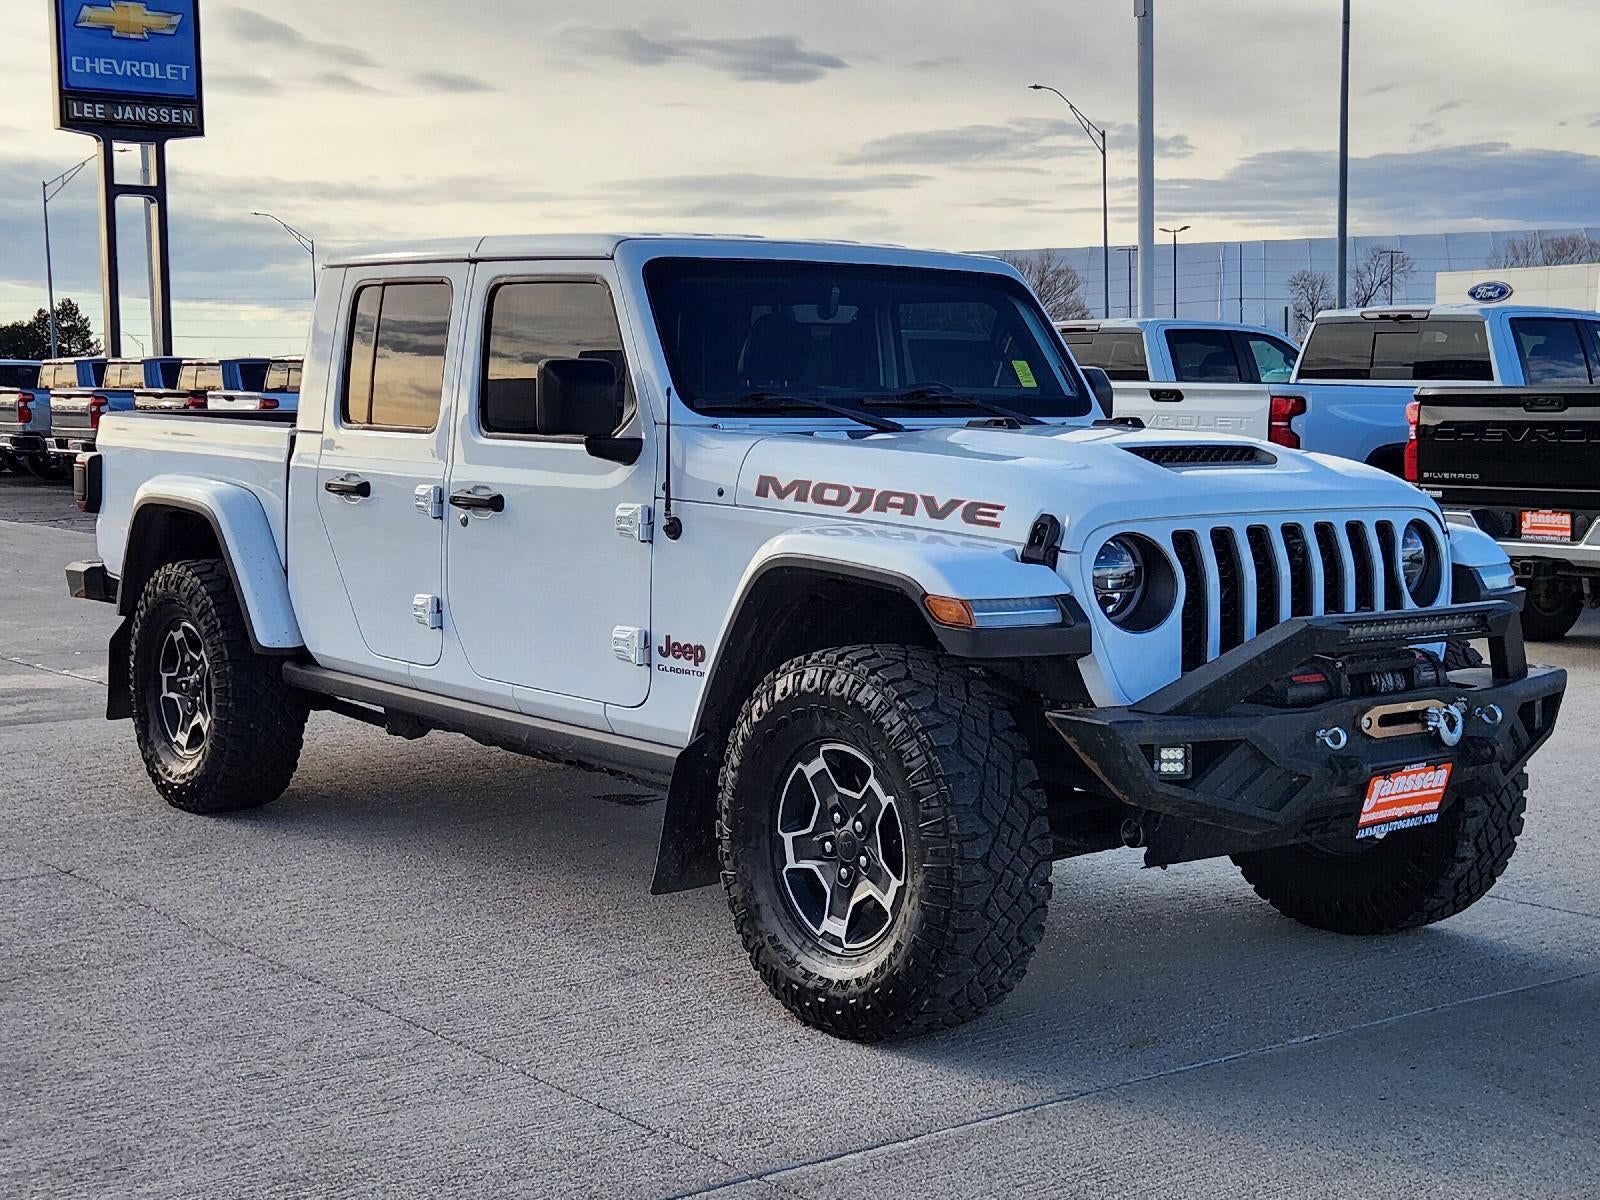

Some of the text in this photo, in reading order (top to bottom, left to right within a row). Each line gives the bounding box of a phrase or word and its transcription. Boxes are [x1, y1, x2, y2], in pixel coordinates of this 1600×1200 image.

[71, 56, 190, 81] CHEVROLET
[73, 102, 193, 124] LEE JANSSEN
[1475, 286, 1500, 299] Ford
[755, 474, 1006, 529] MOJAVE
[657, 634, 706, 667] Jeep
[1362, 768, 1448, 813] Janssen
